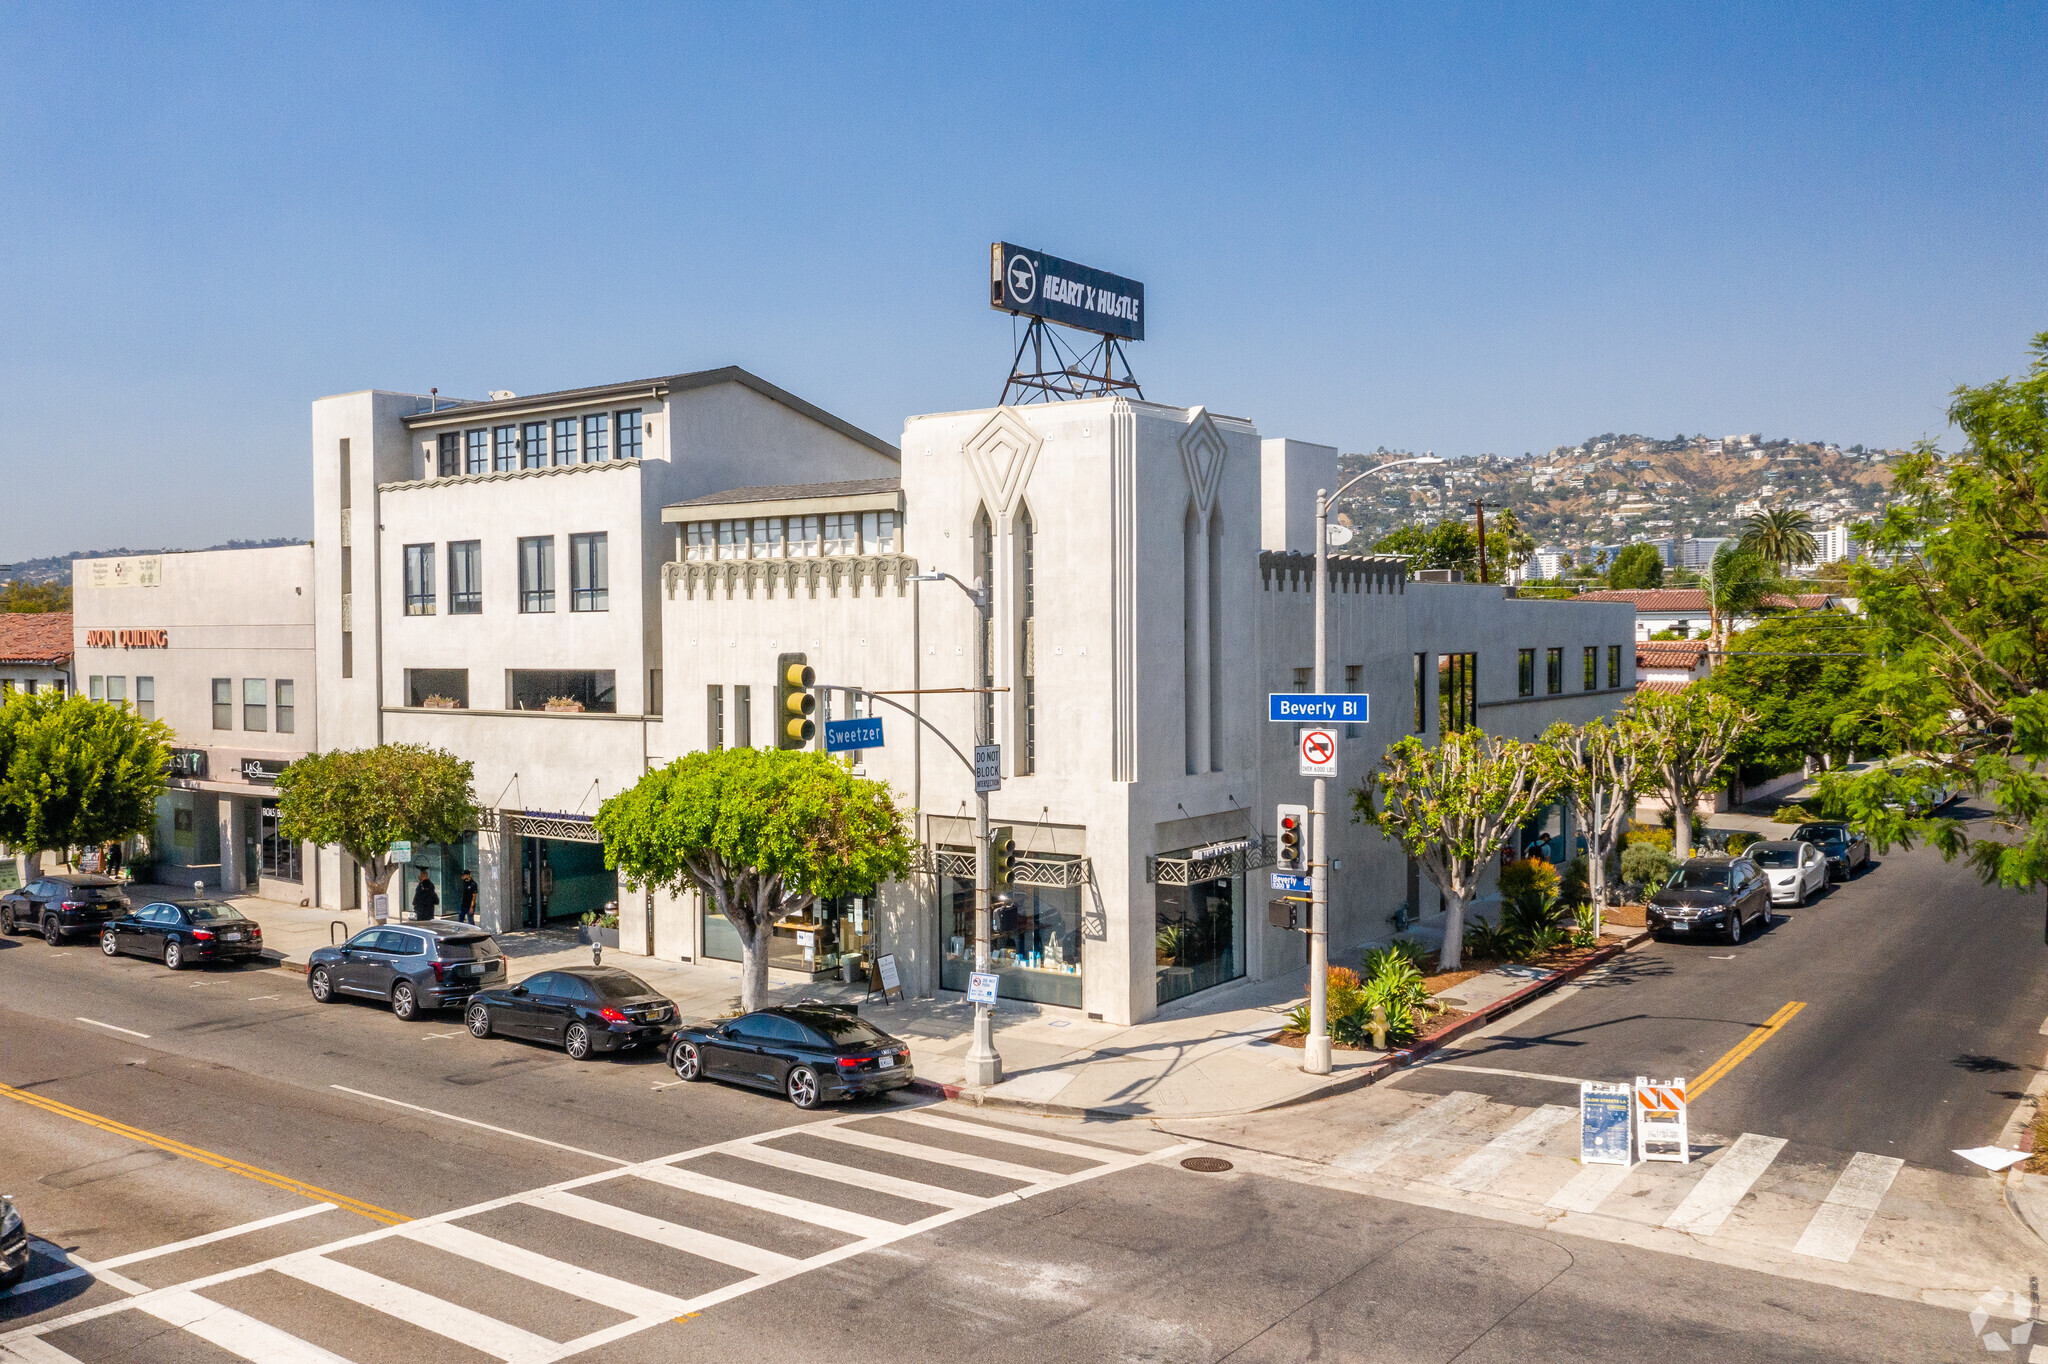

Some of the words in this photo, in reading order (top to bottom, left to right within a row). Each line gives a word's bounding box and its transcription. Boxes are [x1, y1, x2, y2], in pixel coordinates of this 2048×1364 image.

[1042, 274, 1085, 307] HEART
[1085, 285, 1097, 311] X
[1097, 289, 1140, 322] HUSTLE
[86, 629, 115, 647] AVON
[118, 629, 168, 649] QUILTING
[1280, 700, 1336, 719] Beverly
[1343, 701, 1357, 715] Bl
[828, 726, 881, 745] Sweetzer
[976, 752, 986, 763] DO
[986, 750, 999, 762] NOT
[976, 765, 999, 778] BLOCK
[976, 779, 1000, 788] INTERSECTION
[525, 806, 562, 821] backyard
[564, 809, 590, 822] bowls
[1272, 874, 1297, 887] Beverly
